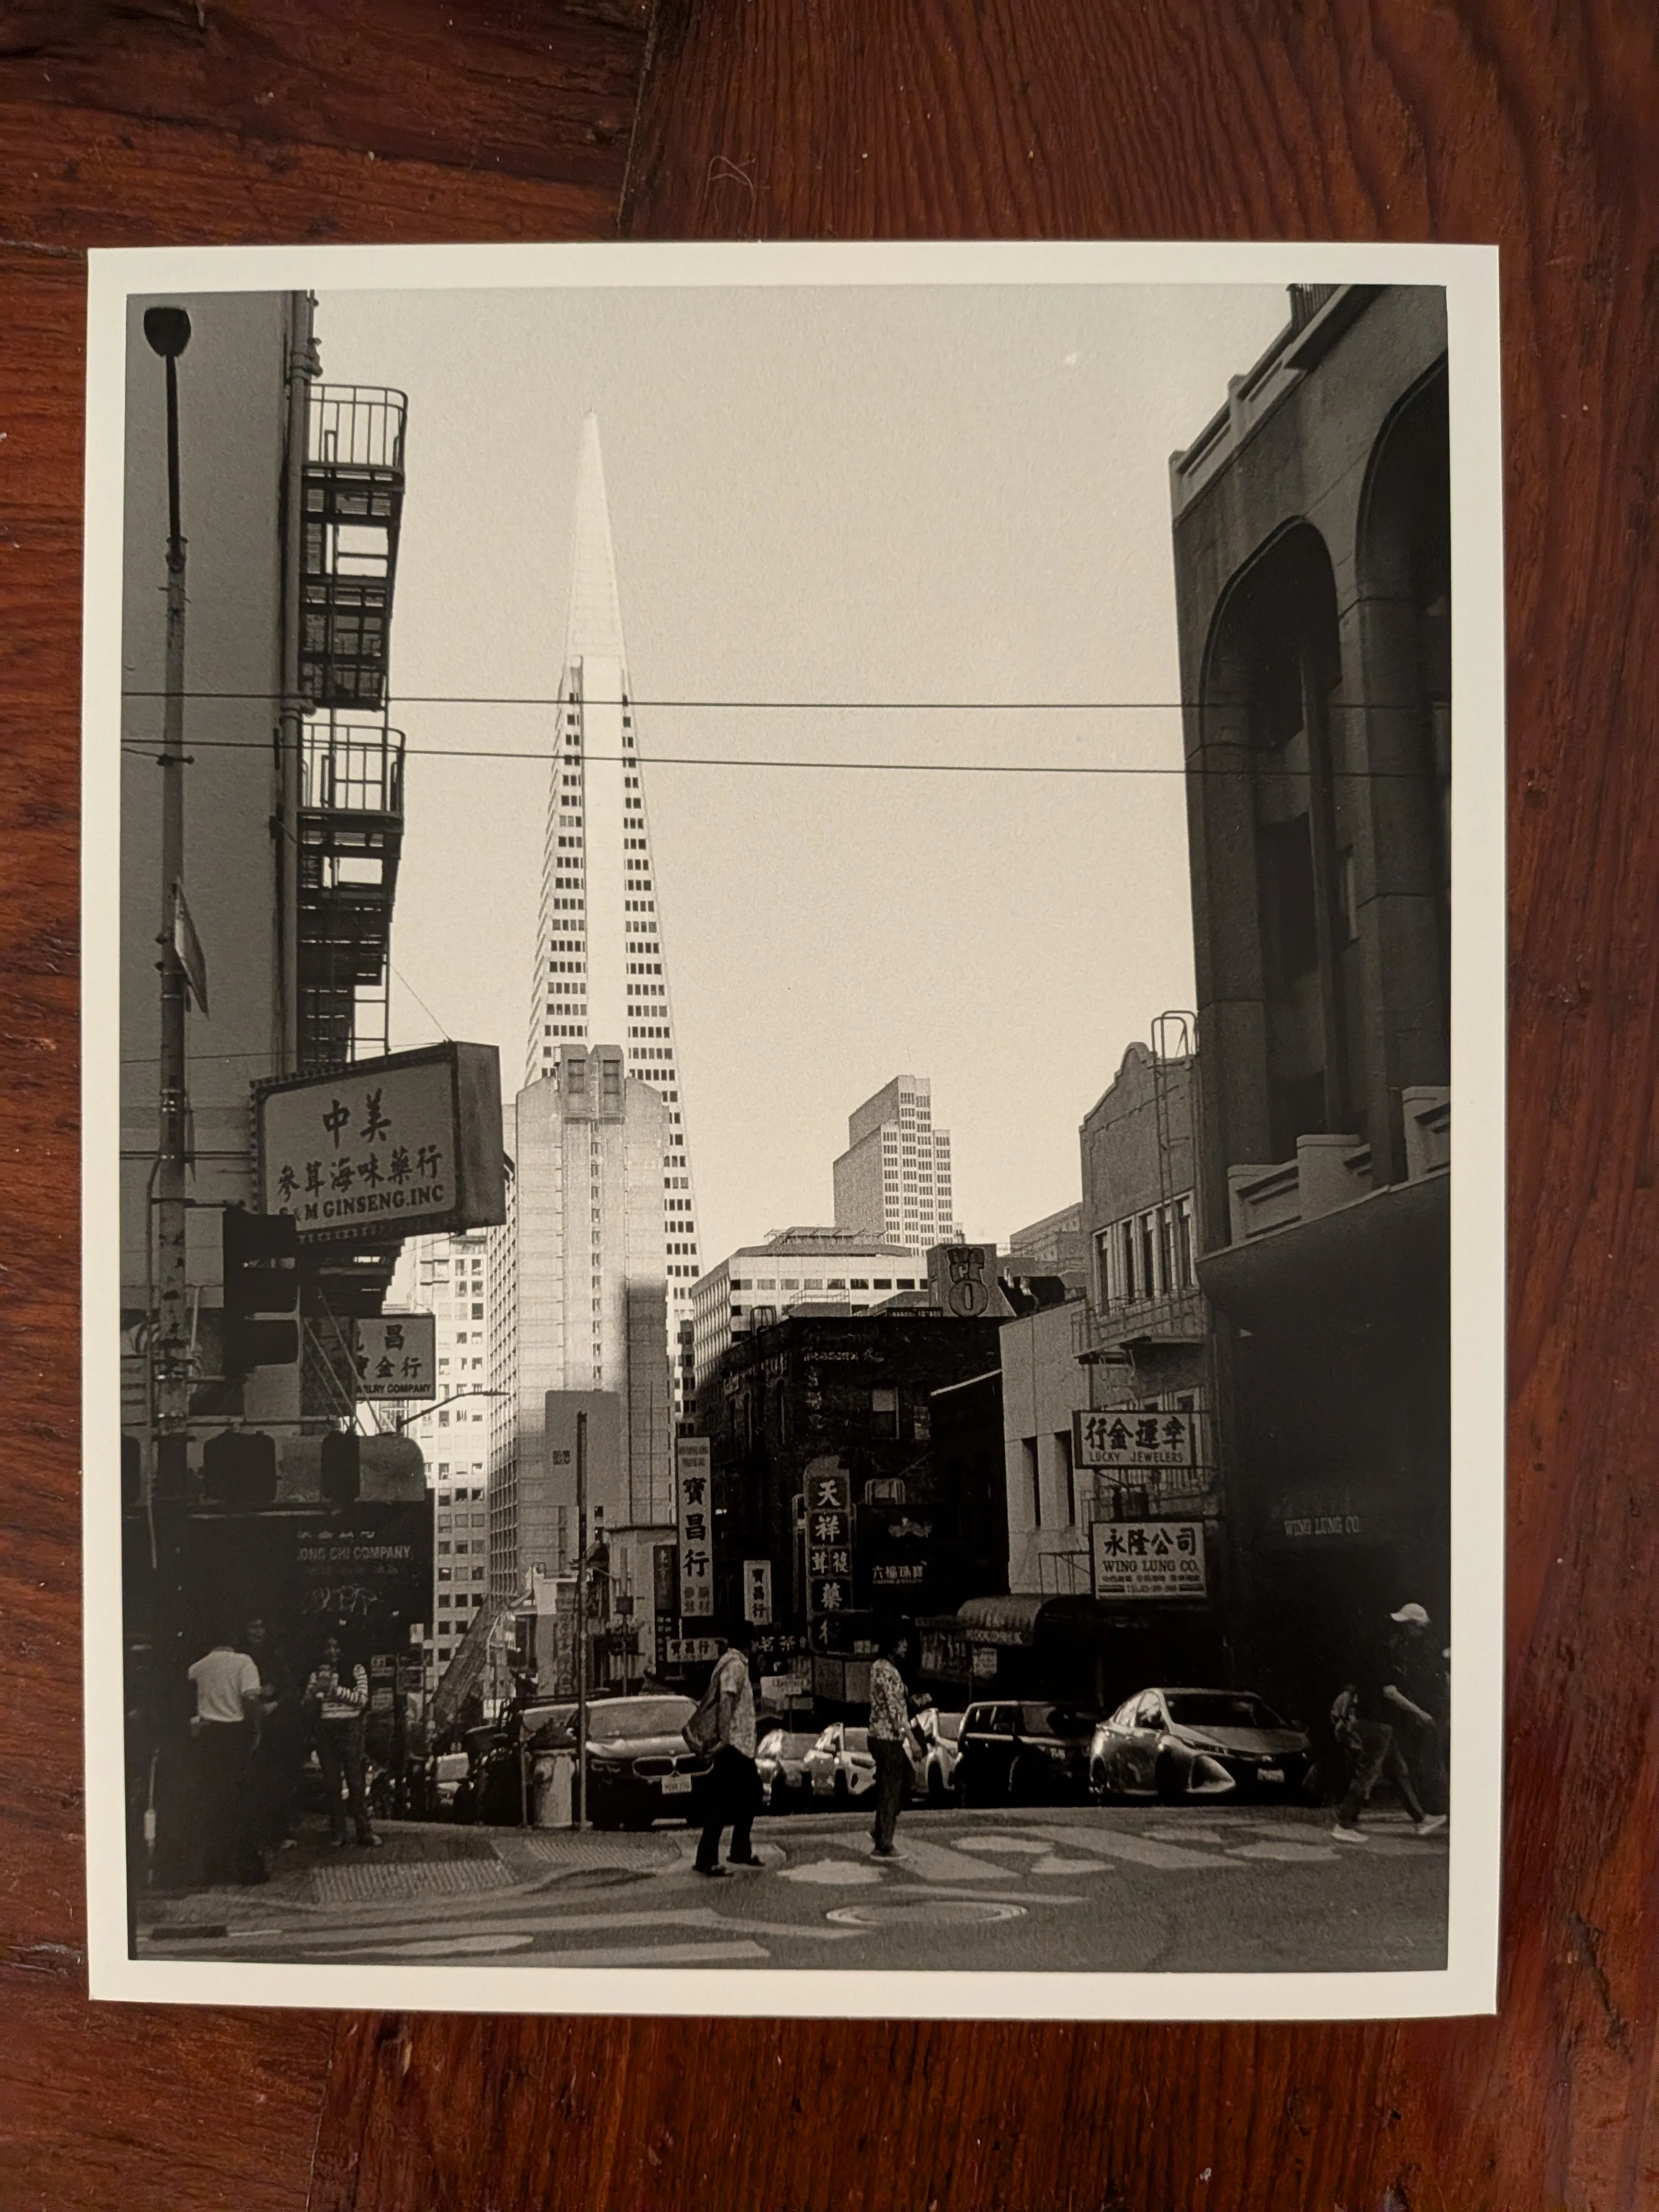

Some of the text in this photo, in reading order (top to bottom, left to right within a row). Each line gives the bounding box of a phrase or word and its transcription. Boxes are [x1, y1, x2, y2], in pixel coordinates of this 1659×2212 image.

[323, 1088, 392, 1149] 中美
[304, 1203, 319, 1220] M
[388, 1384, 431, 1394] COMPANY
[1089, 1451, 1184, 1463] LUCKY JEWELERS
[1104, 1527, 1196, 1557] 永隆公司
[353, 1545, 411, 1560] COMPANY
[1103, 1560, 1138, 1572] WING
[1142, 1560, 1176, 1572] LUNG
